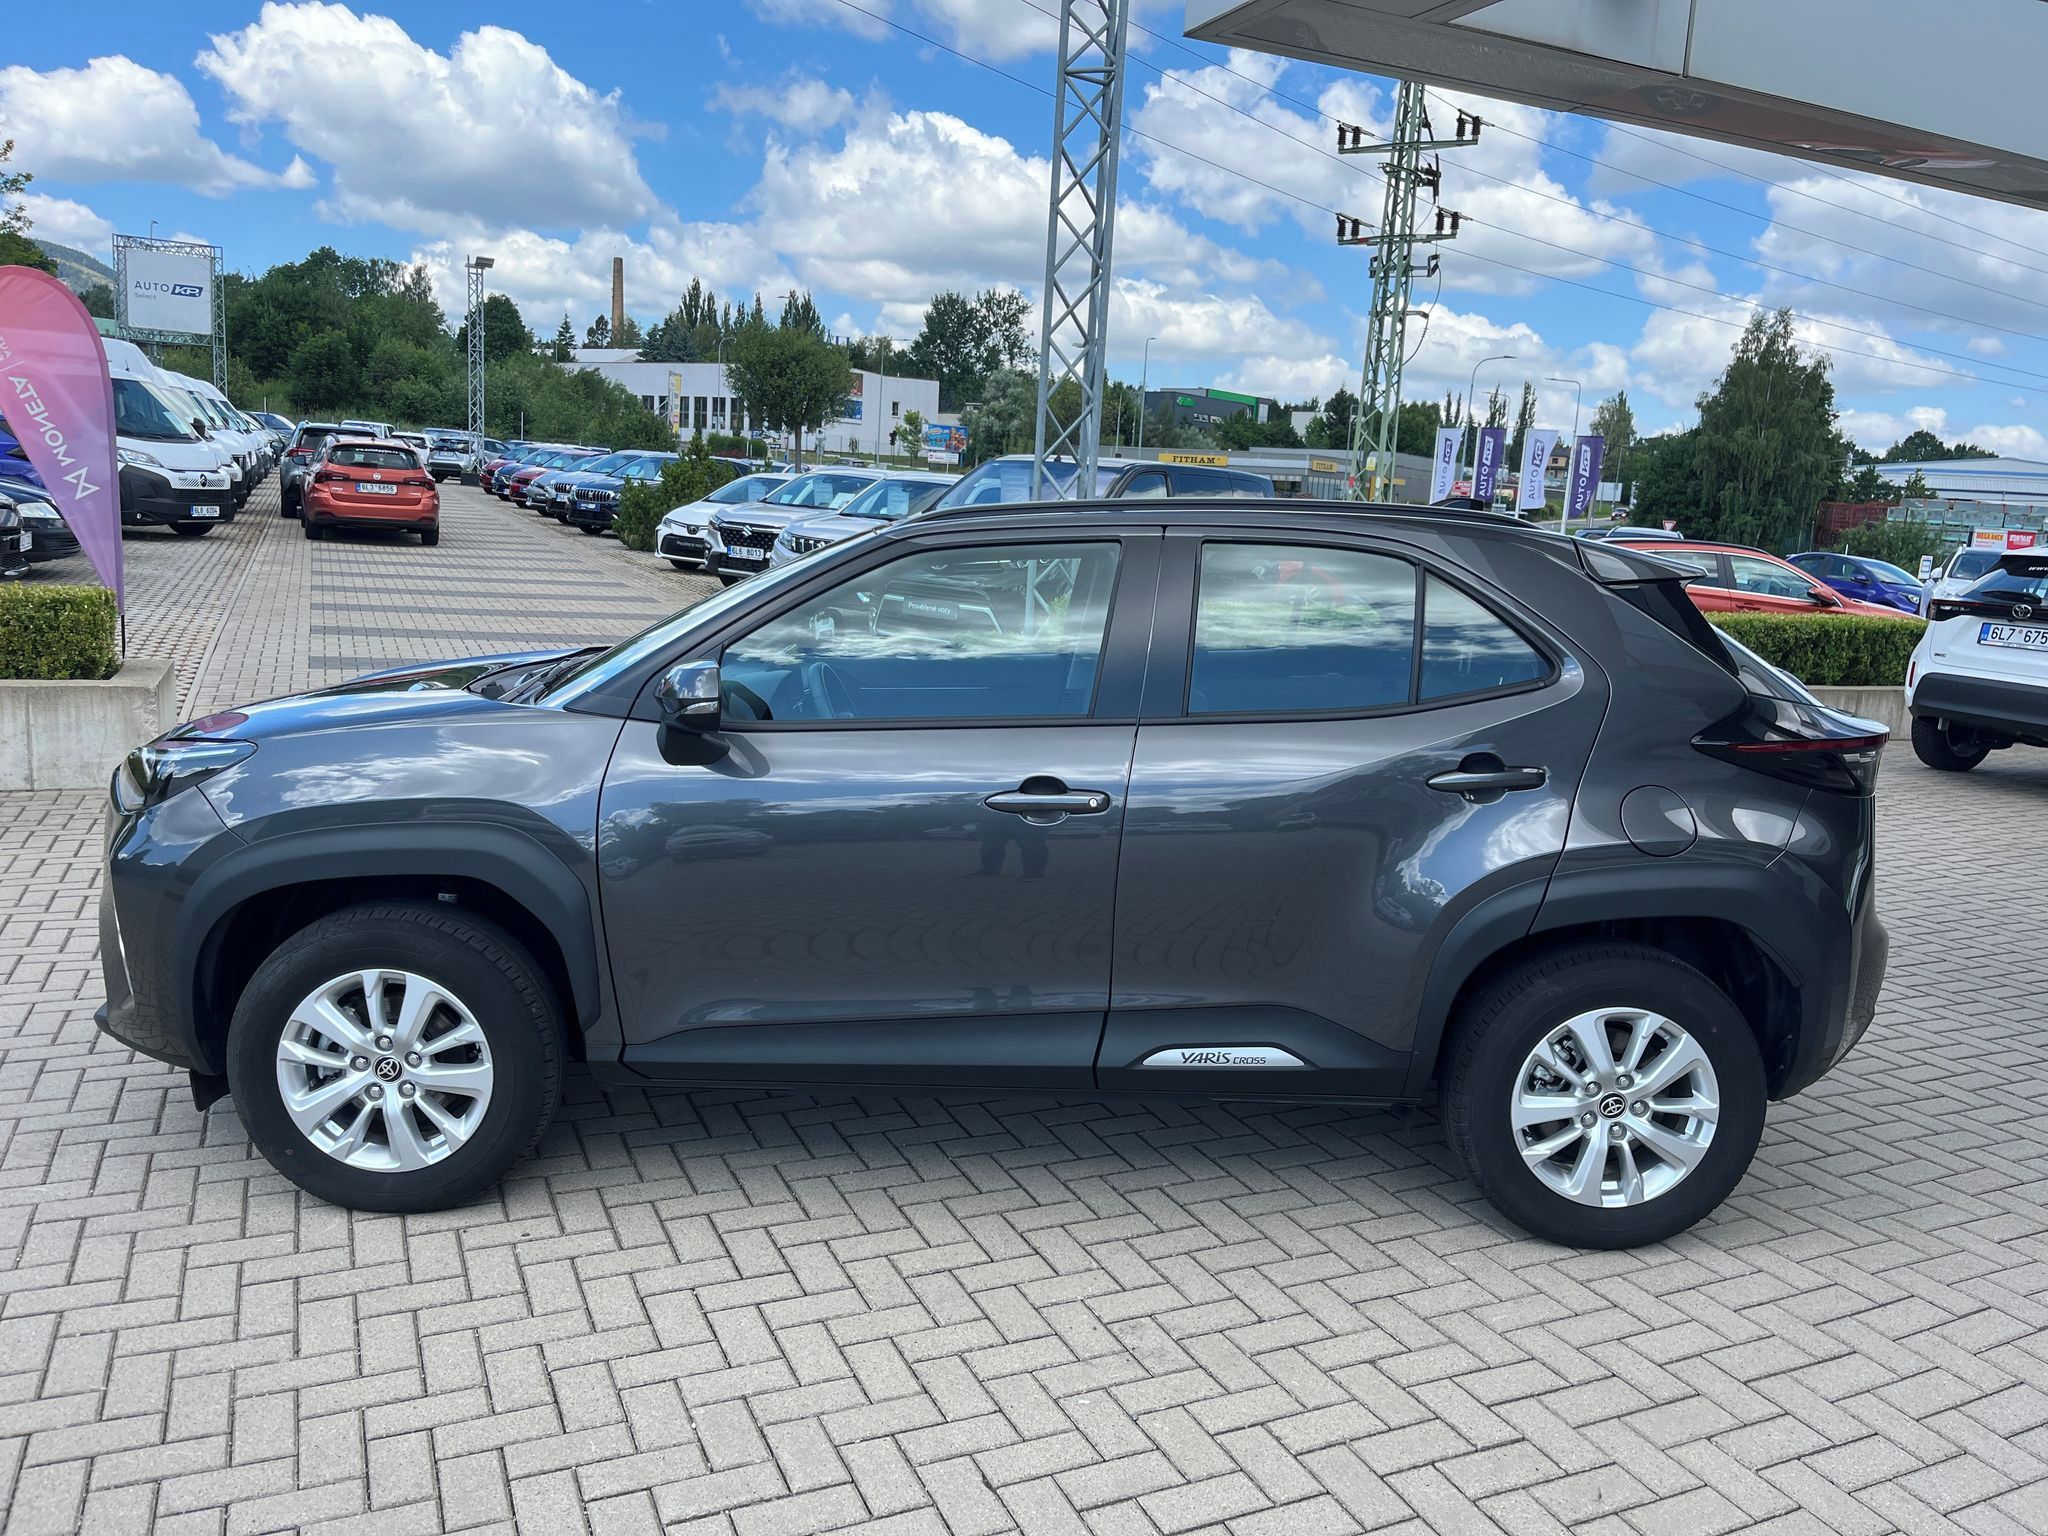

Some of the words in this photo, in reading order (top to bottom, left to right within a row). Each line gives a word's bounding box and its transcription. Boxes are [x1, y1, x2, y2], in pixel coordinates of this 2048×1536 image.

[134, 281, 170, 293] AUTO
[1172, 455, 1216, 464] FITHAM
[1315, 462, 1333, 471] FITHAM
[1479, 466, 1489, 496] AUTO
[1528, 469, 1539, 499] AUTO
[1575, 477, 1587, 510] AUTO
[731, 546, 743, 555] 6L6
[746, 548, 762, 557] 8013
[938, 607, 952, 616] vozy
[1990, 626, 2016, 641] 6L7
[1233, 1056, 1267, 1065] CROSS
